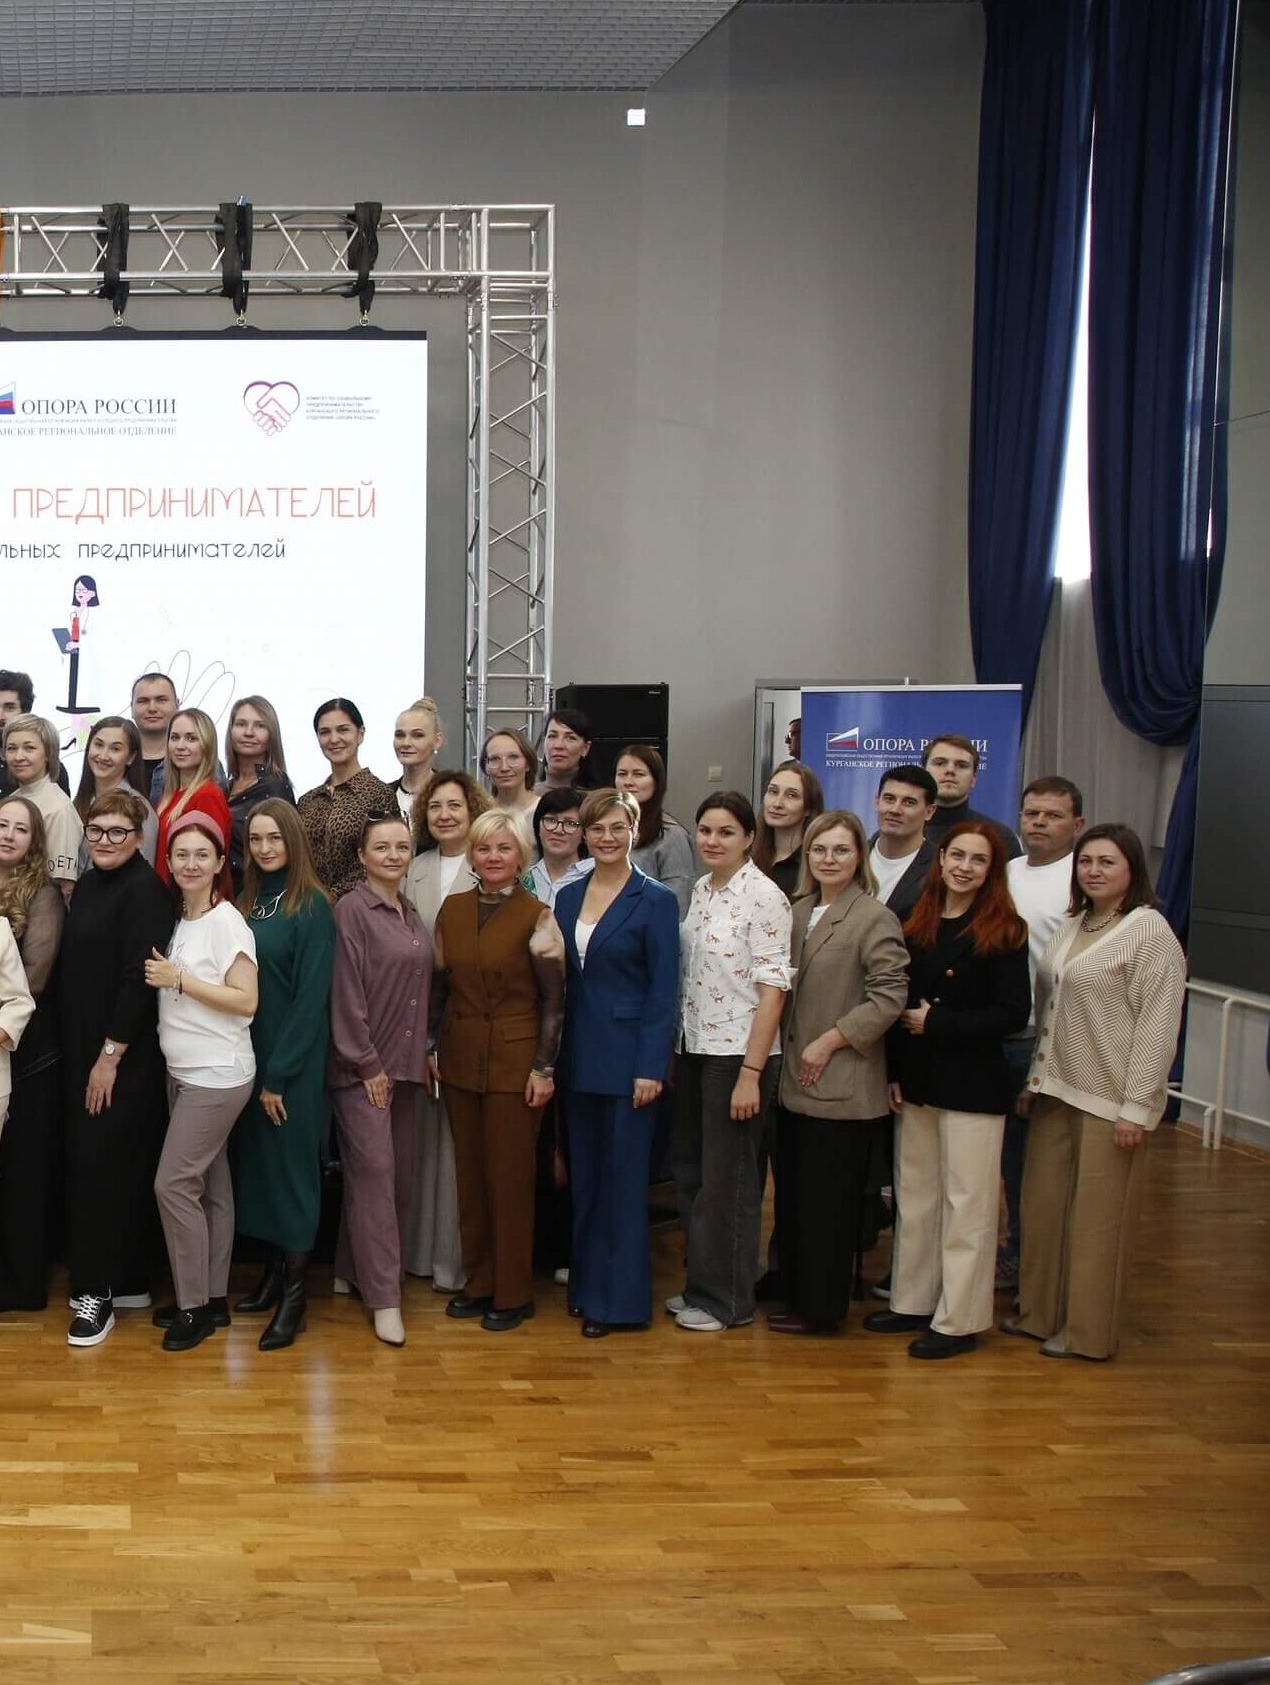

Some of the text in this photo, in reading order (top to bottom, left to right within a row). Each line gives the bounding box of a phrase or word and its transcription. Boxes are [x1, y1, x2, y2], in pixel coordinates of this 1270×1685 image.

[21, 398, 175, 415] ОПОРА РОССИИ
[39, 427, 116, 437] РЕГИОНАЛЬНОЕ
[118, 426, 177, 437] ОТДЕЛЕНИЕ
[13, 480, 376, 525] ПРЕДПРИНИМАТЕЛЕЙ
[78, 538, 286, 562] предпринимателей
[863, 738, 914, 751] ОПОРА
